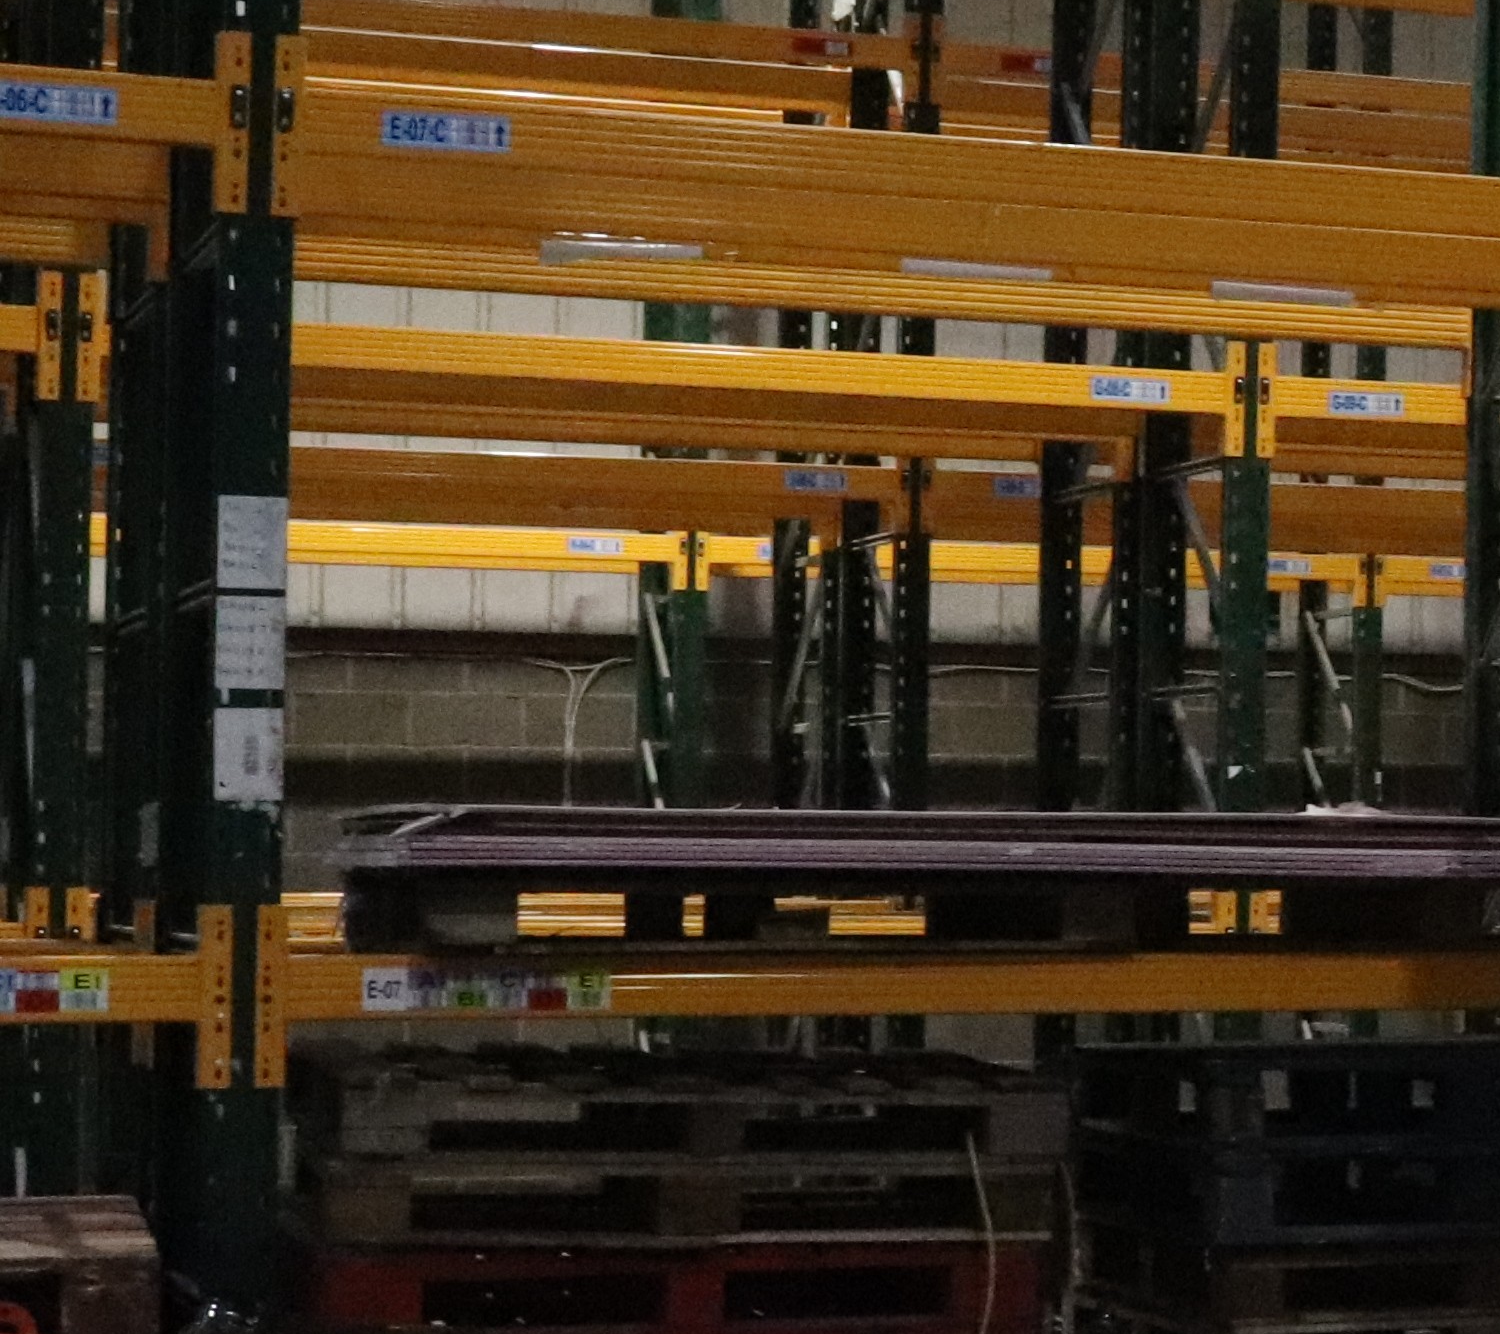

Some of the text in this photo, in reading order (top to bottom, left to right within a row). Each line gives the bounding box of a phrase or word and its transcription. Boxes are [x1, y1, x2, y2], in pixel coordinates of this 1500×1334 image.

[0, 87, 48, 114] -06-C
[389, 116, 449, 144] E-07-C
[366, 979, 403, 1000] E-07
